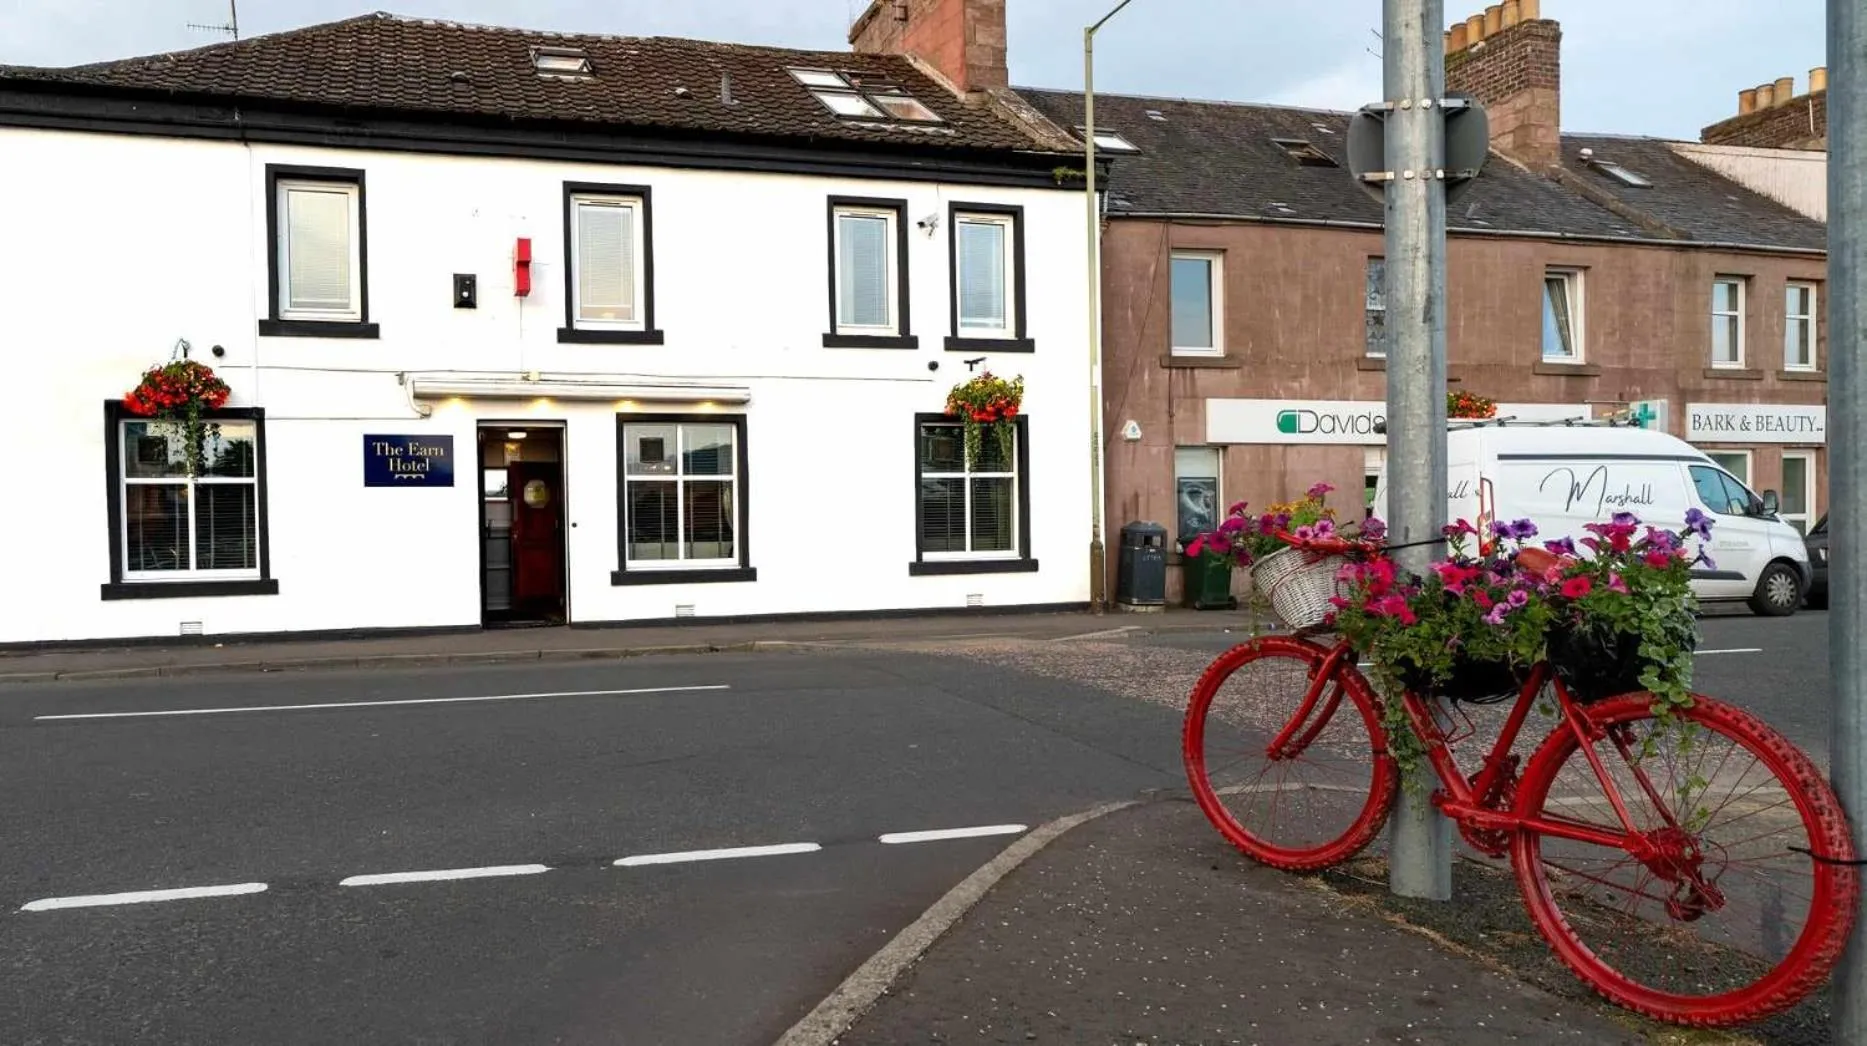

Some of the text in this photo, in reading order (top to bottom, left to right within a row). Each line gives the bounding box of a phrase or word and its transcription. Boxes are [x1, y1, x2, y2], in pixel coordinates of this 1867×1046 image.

[1692, 413, 1735, 431] BARK
[1740, 414, 1752, 431] &
[372, 441, 444, 456] The Earn
[389, 457, 430, 472] Hotel
[1539, 465, 1655, 517] Marshall
